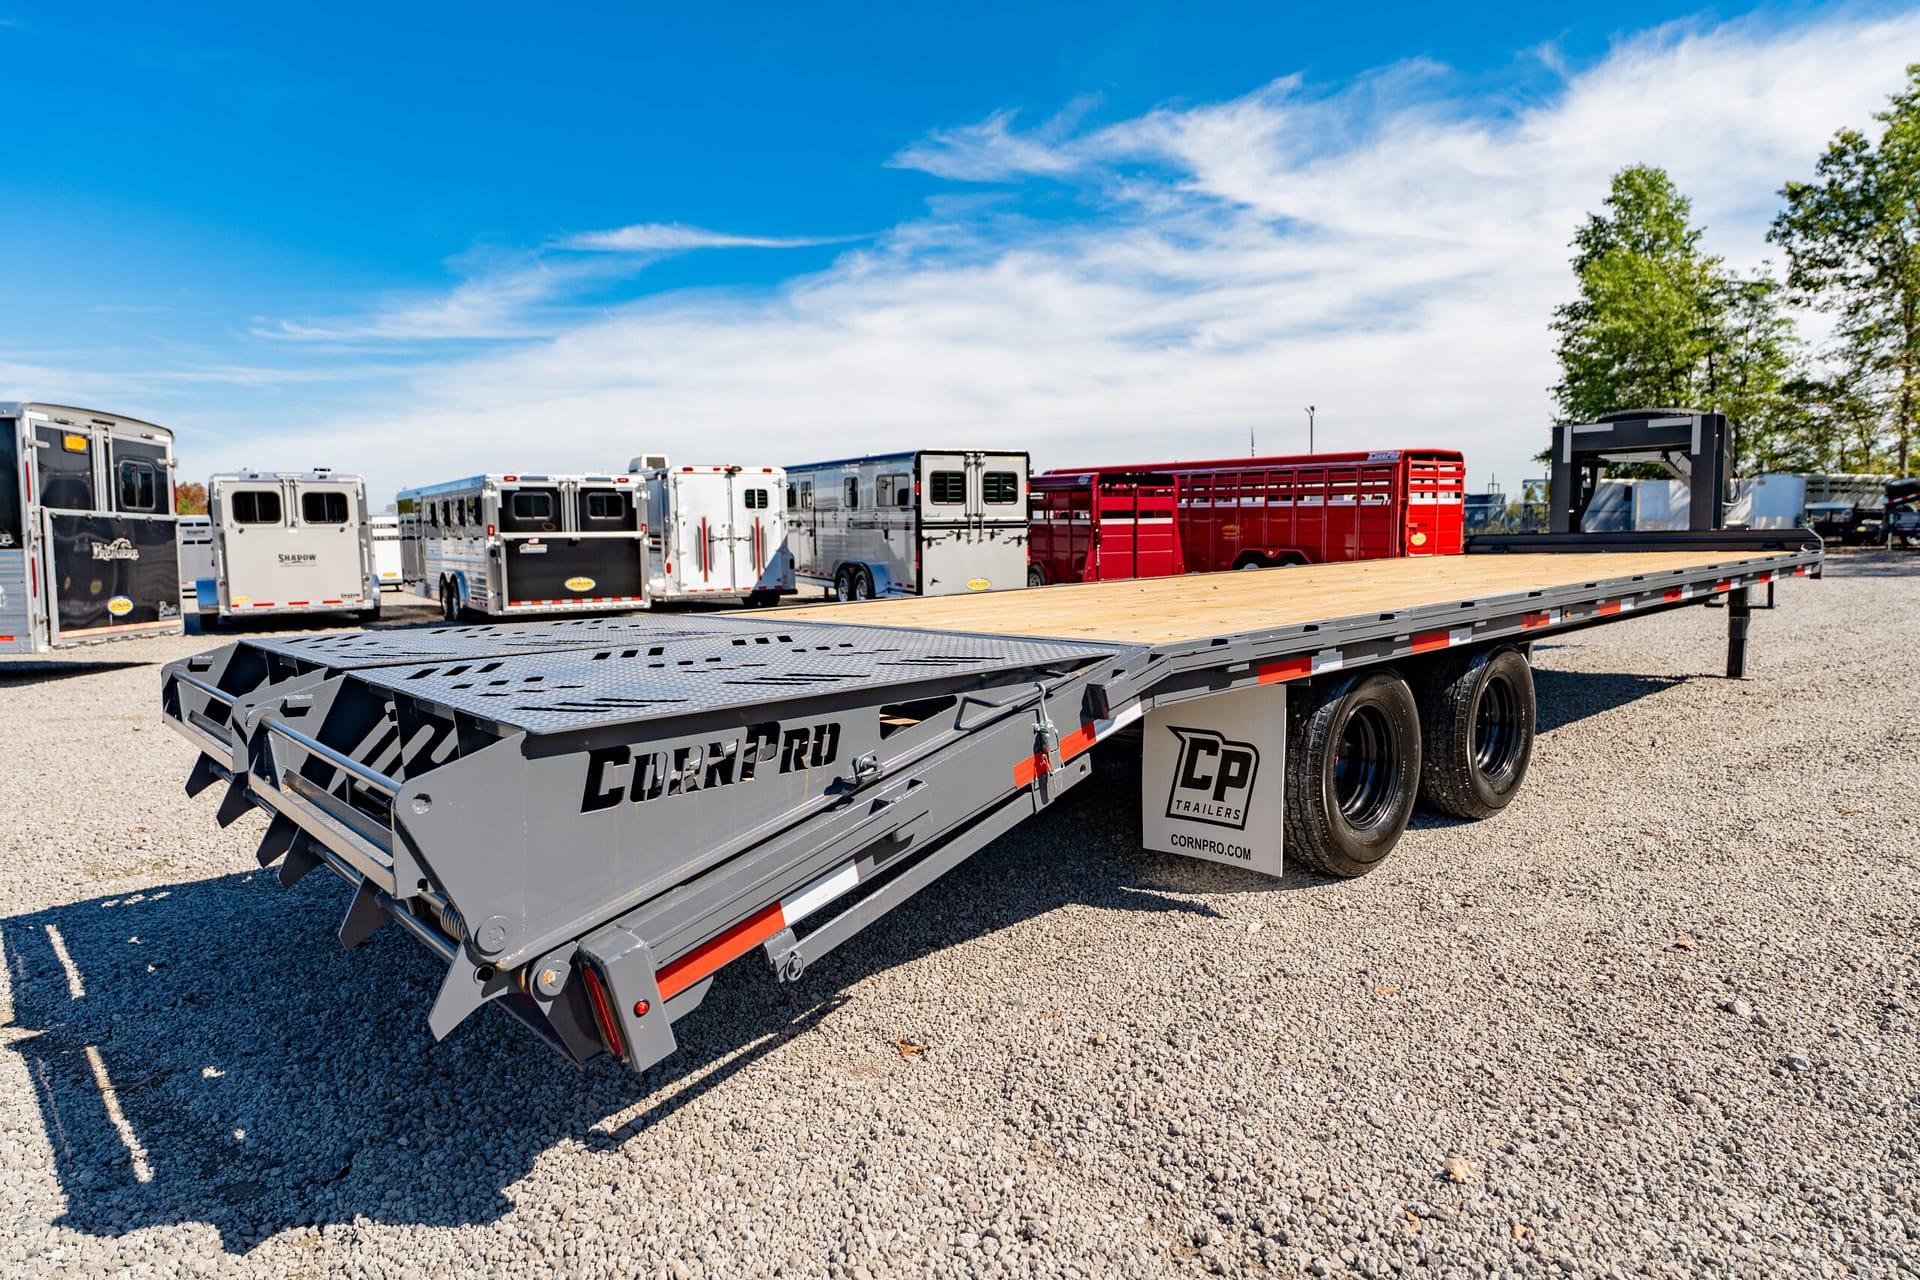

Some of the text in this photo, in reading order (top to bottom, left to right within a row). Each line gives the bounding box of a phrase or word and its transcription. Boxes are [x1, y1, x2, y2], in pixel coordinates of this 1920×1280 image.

[278, 553, 317, 563] SHADOW
[1180, 736, 1253, 802] CP
[1175, 799, 1242, 820] TRAILERS
[1170, 833, 1252, 861] CORNPRO.COM
